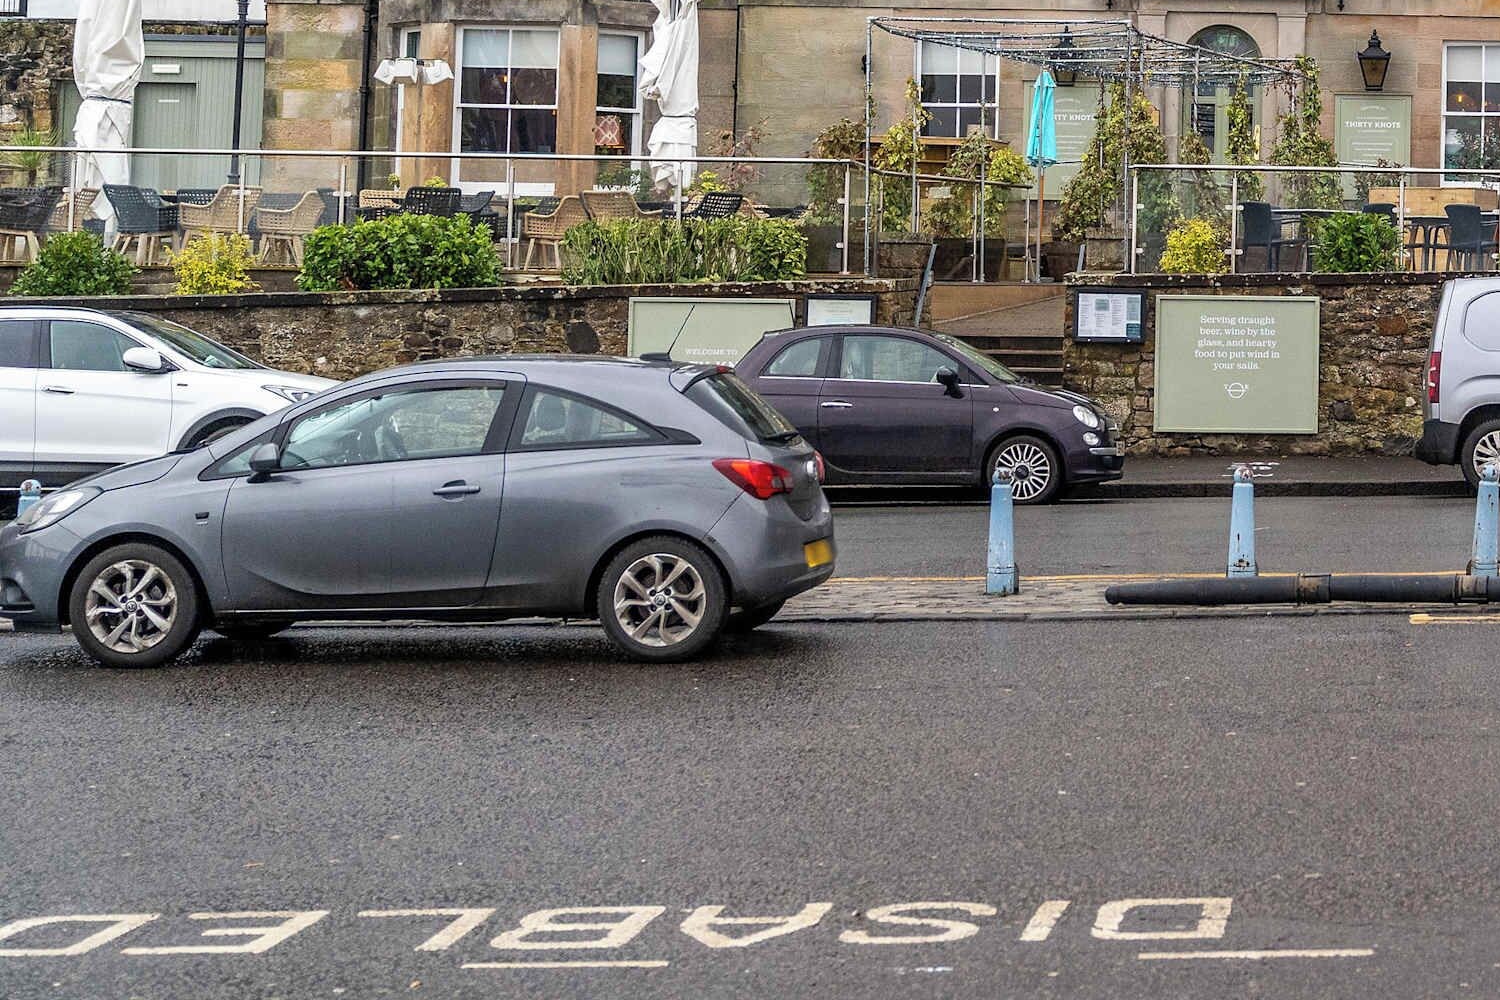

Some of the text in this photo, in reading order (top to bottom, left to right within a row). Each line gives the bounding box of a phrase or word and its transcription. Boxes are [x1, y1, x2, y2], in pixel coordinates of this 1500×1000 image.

[1200, 315, 1275, 326] Serving draught
[1200, 327, 1276, 337] beer, wine by the
[1198, 339, 1277, 349] glass, and hearty
[1194, 350, 1280, 360] food to put wind in
[1213, 362, 1235, 371] your
[0, 897, 1234, 956] DISABLED
